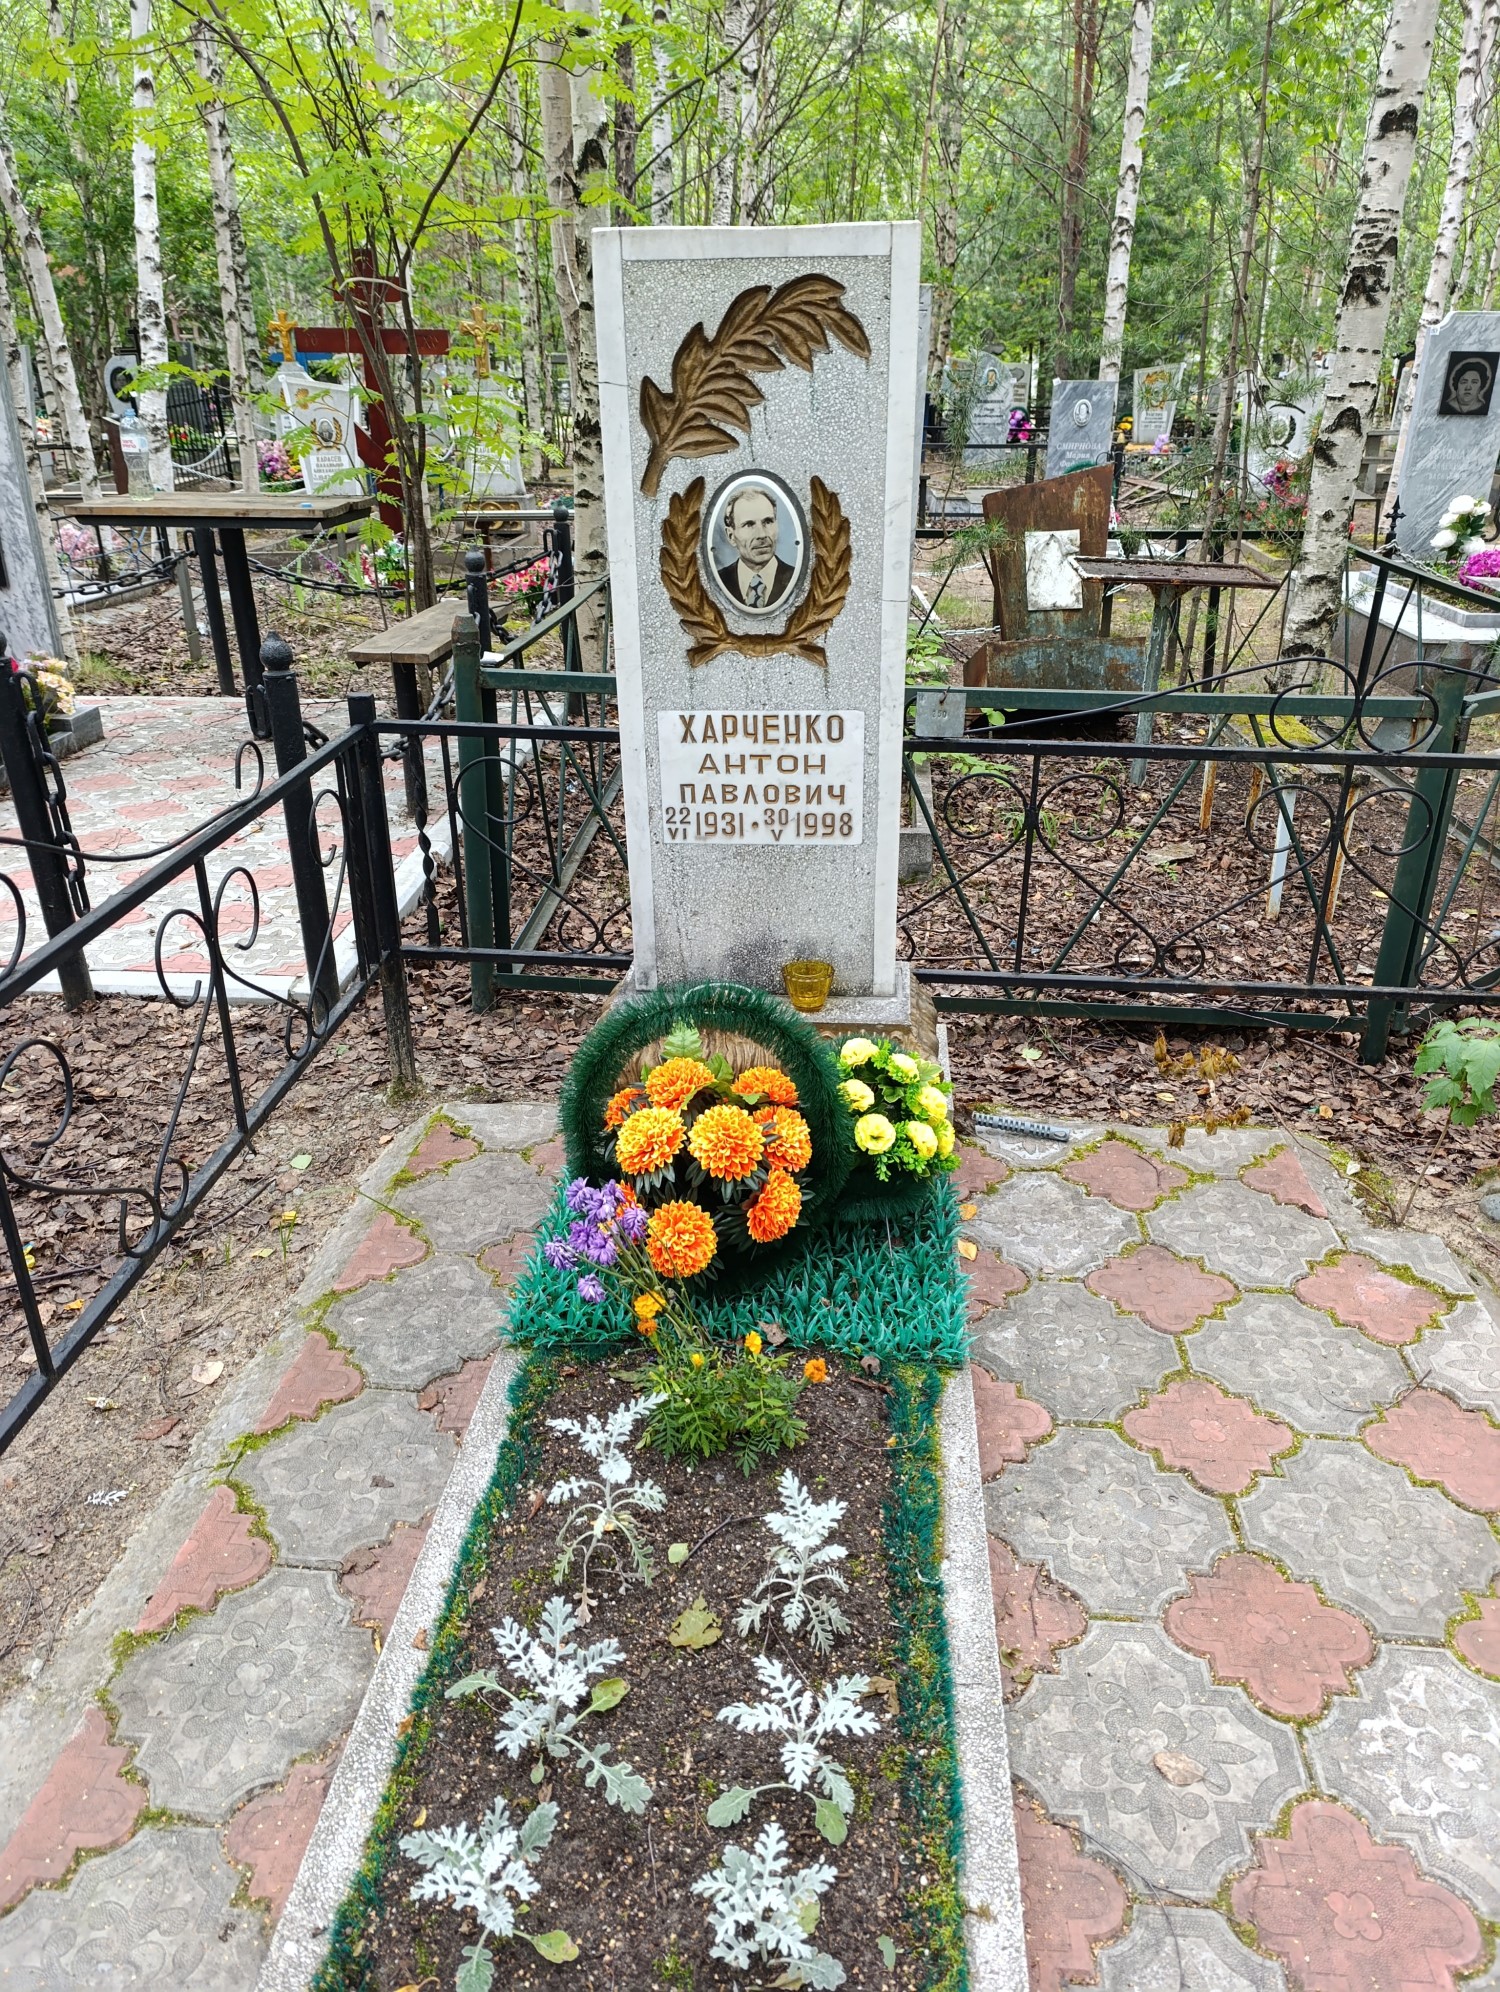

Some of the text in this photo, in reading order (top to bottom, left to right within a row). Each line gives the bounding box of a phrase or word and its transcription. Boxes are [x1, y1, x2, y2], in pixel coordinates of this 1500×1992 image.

[678, 714, 845, 744] ХАРЧЕНКО
[698, 753, 826, 775] АНТОН
[679, 783, 846, 805] ПАВЛОВИЧ
[665, 806, 853, 842] 22 VI 1931 30 V 1998
